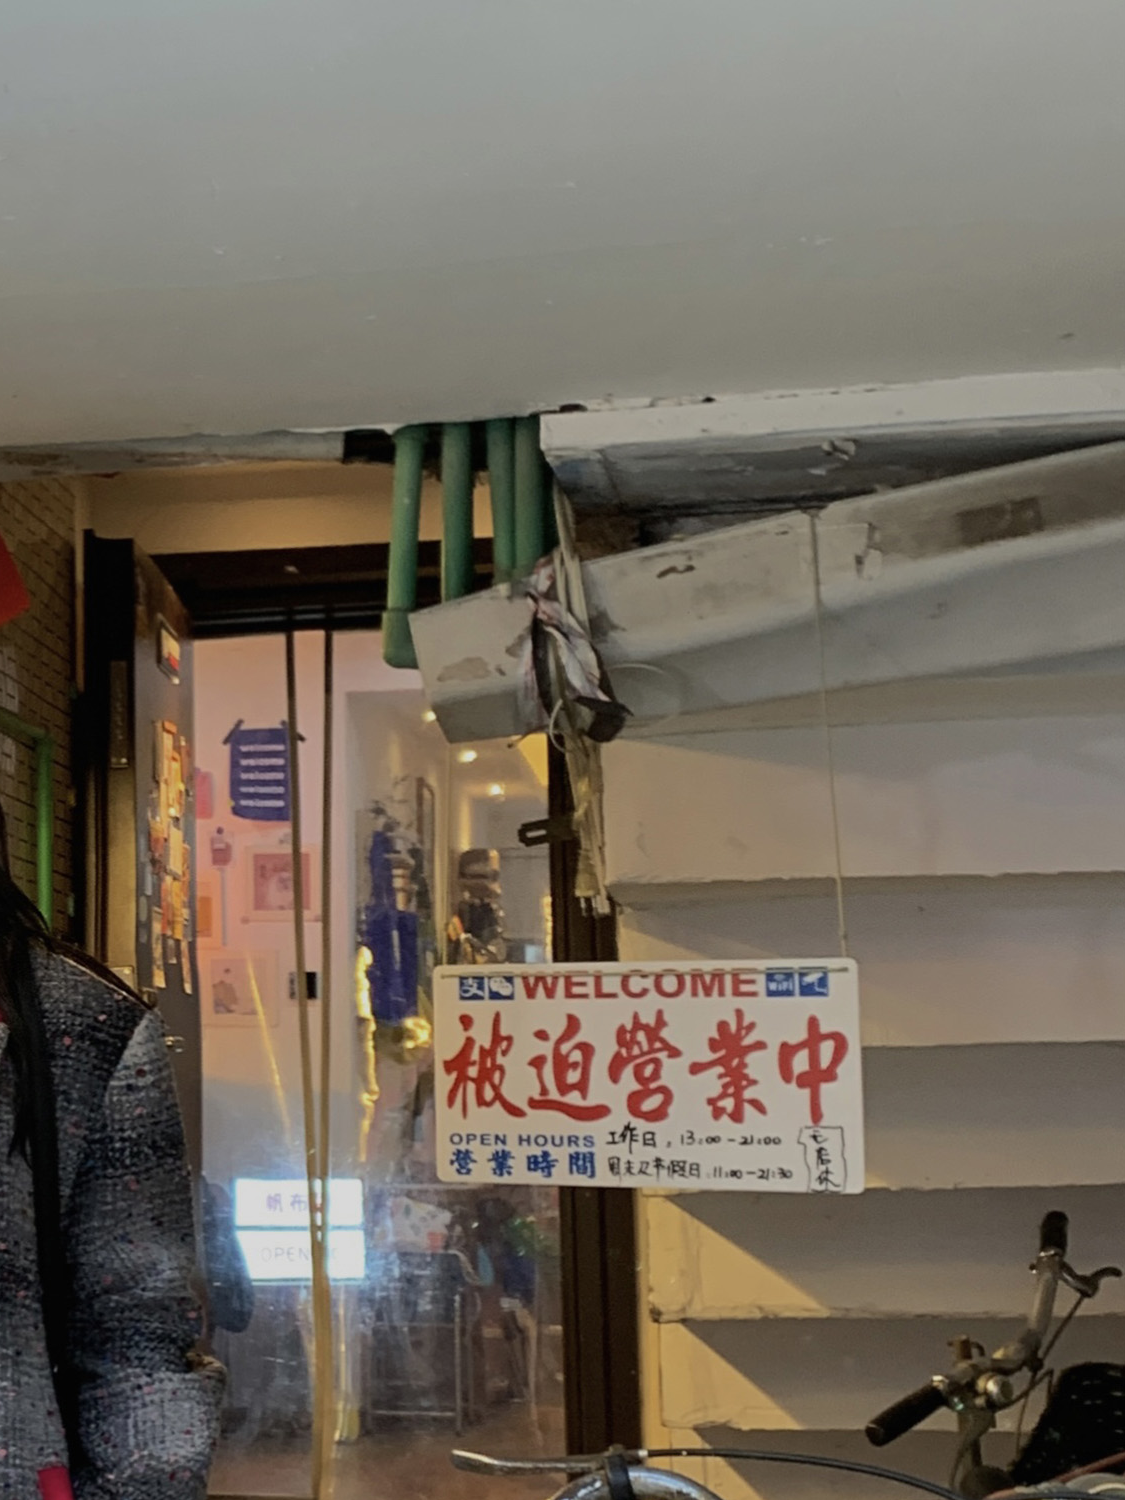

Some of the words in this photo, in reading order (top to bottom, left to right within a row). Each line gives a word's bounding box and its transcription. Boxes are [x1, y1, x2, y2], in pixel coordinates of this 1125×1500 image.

[521, 968, 759, 1000] WELCOME
[443, 1008, 849, 1126] 被迫營業中
[449, 1133, 507, 1146] OPEN
[518, 1134, 595, 1148] HOURS
[449, 1148, 596, 1179] 營業時間
[260, 1246, 310, 1263] OPEN
